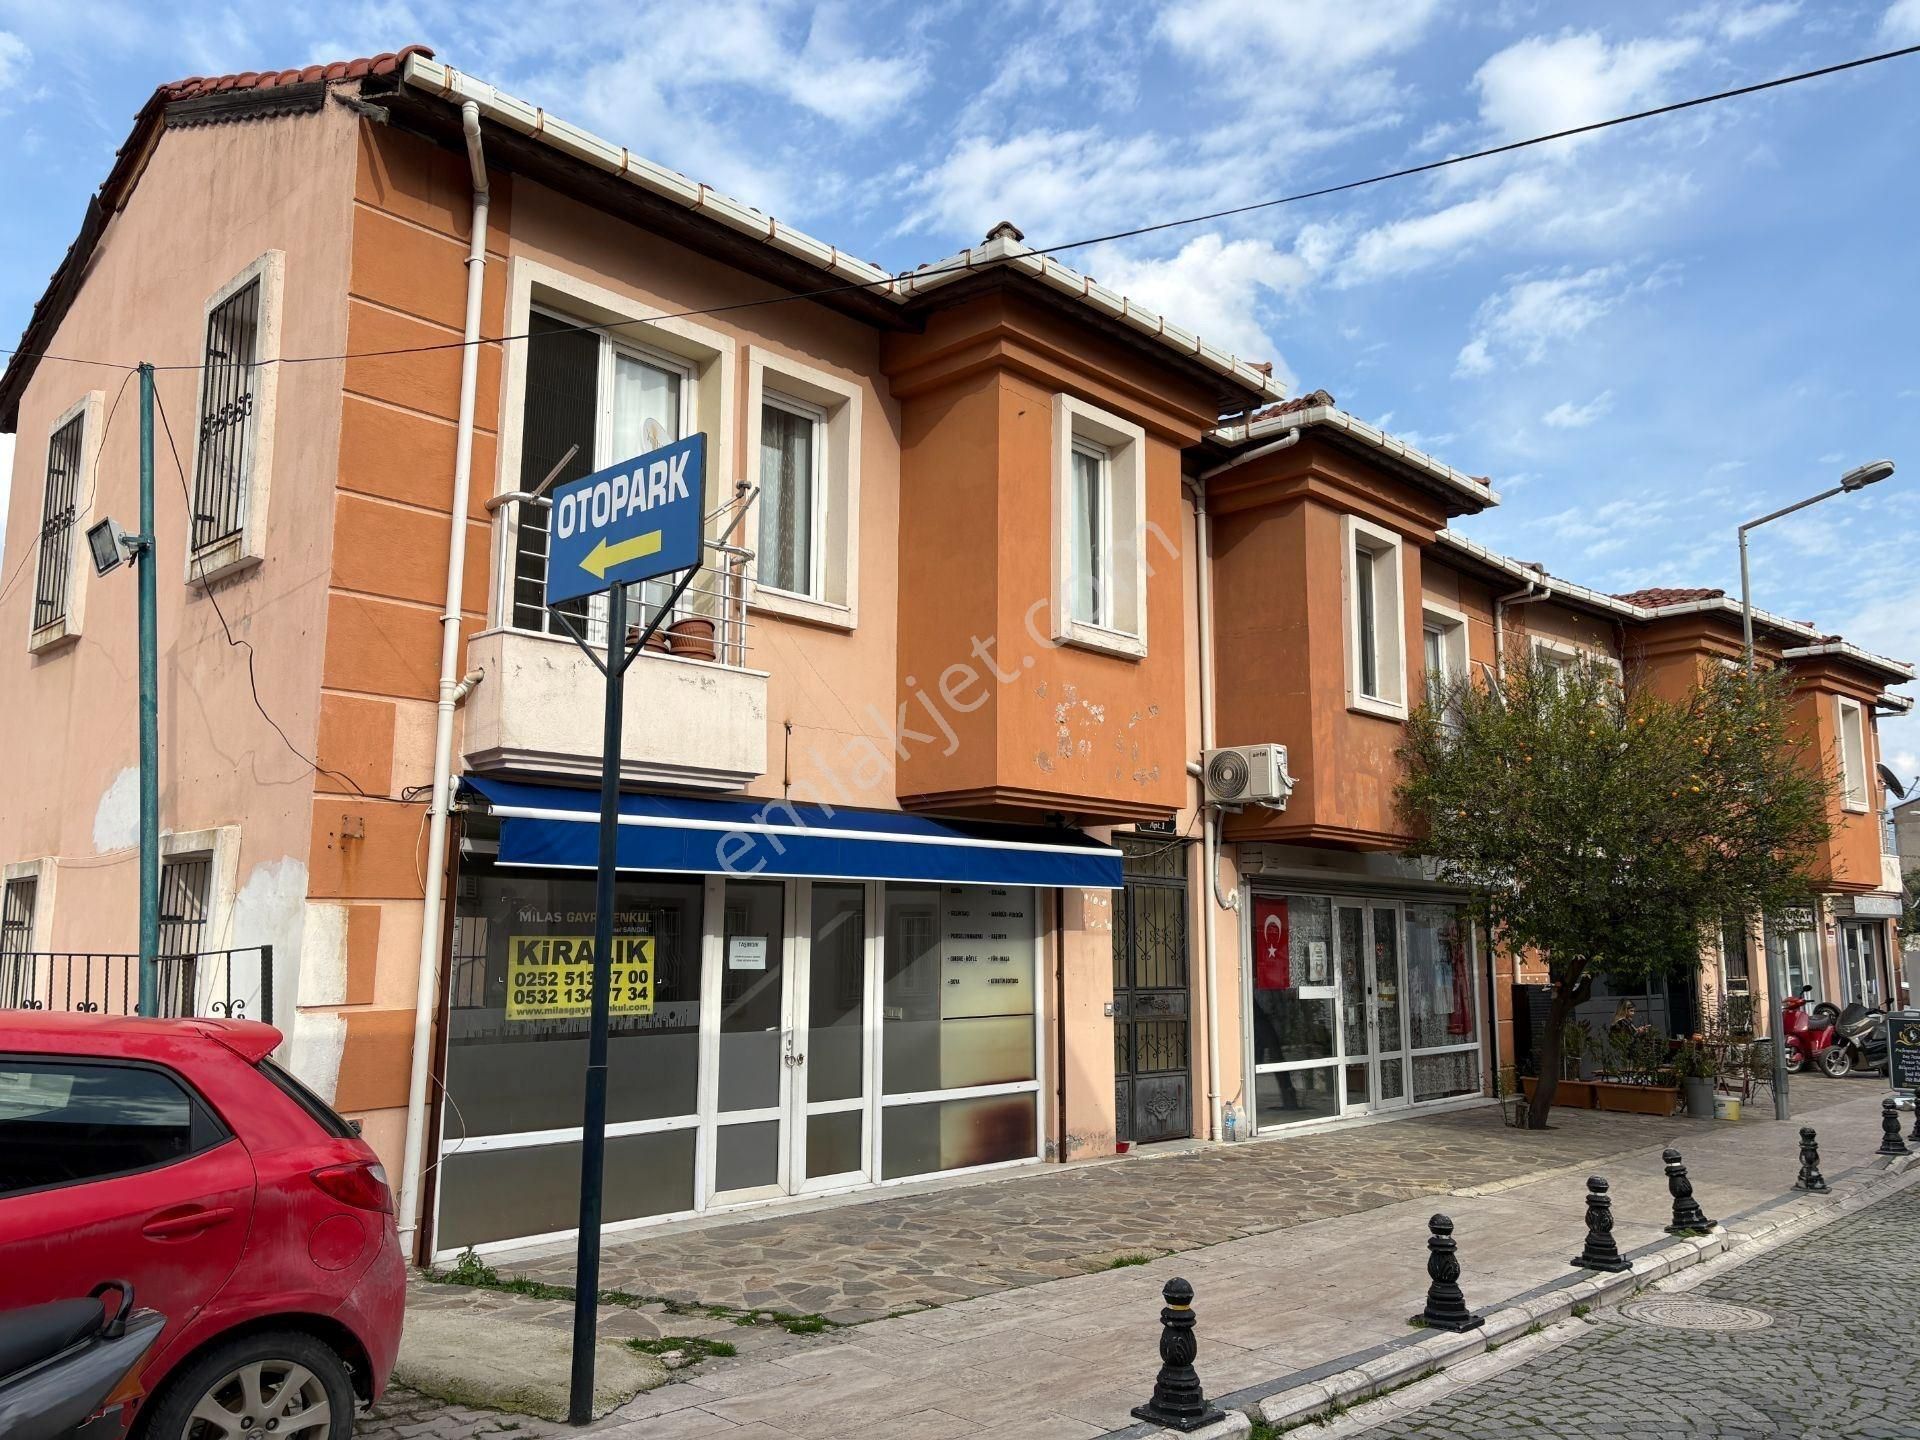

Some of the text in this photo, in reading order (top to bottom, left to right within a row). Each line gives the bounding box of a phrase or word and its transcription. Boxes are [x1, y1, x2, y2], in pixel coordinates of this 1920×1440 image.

[557, 450, 691, 539] OTOPARK
[566, 911, 652, 923] GAYRENKUL
[517, 940, 649, 965] KiRAIK
[515, 971, 558, 987] 0252
[628, 970, 649, 984] 00
[514, 989, 558, 1005] 0532
[627, 987, 649, 1000] 34
